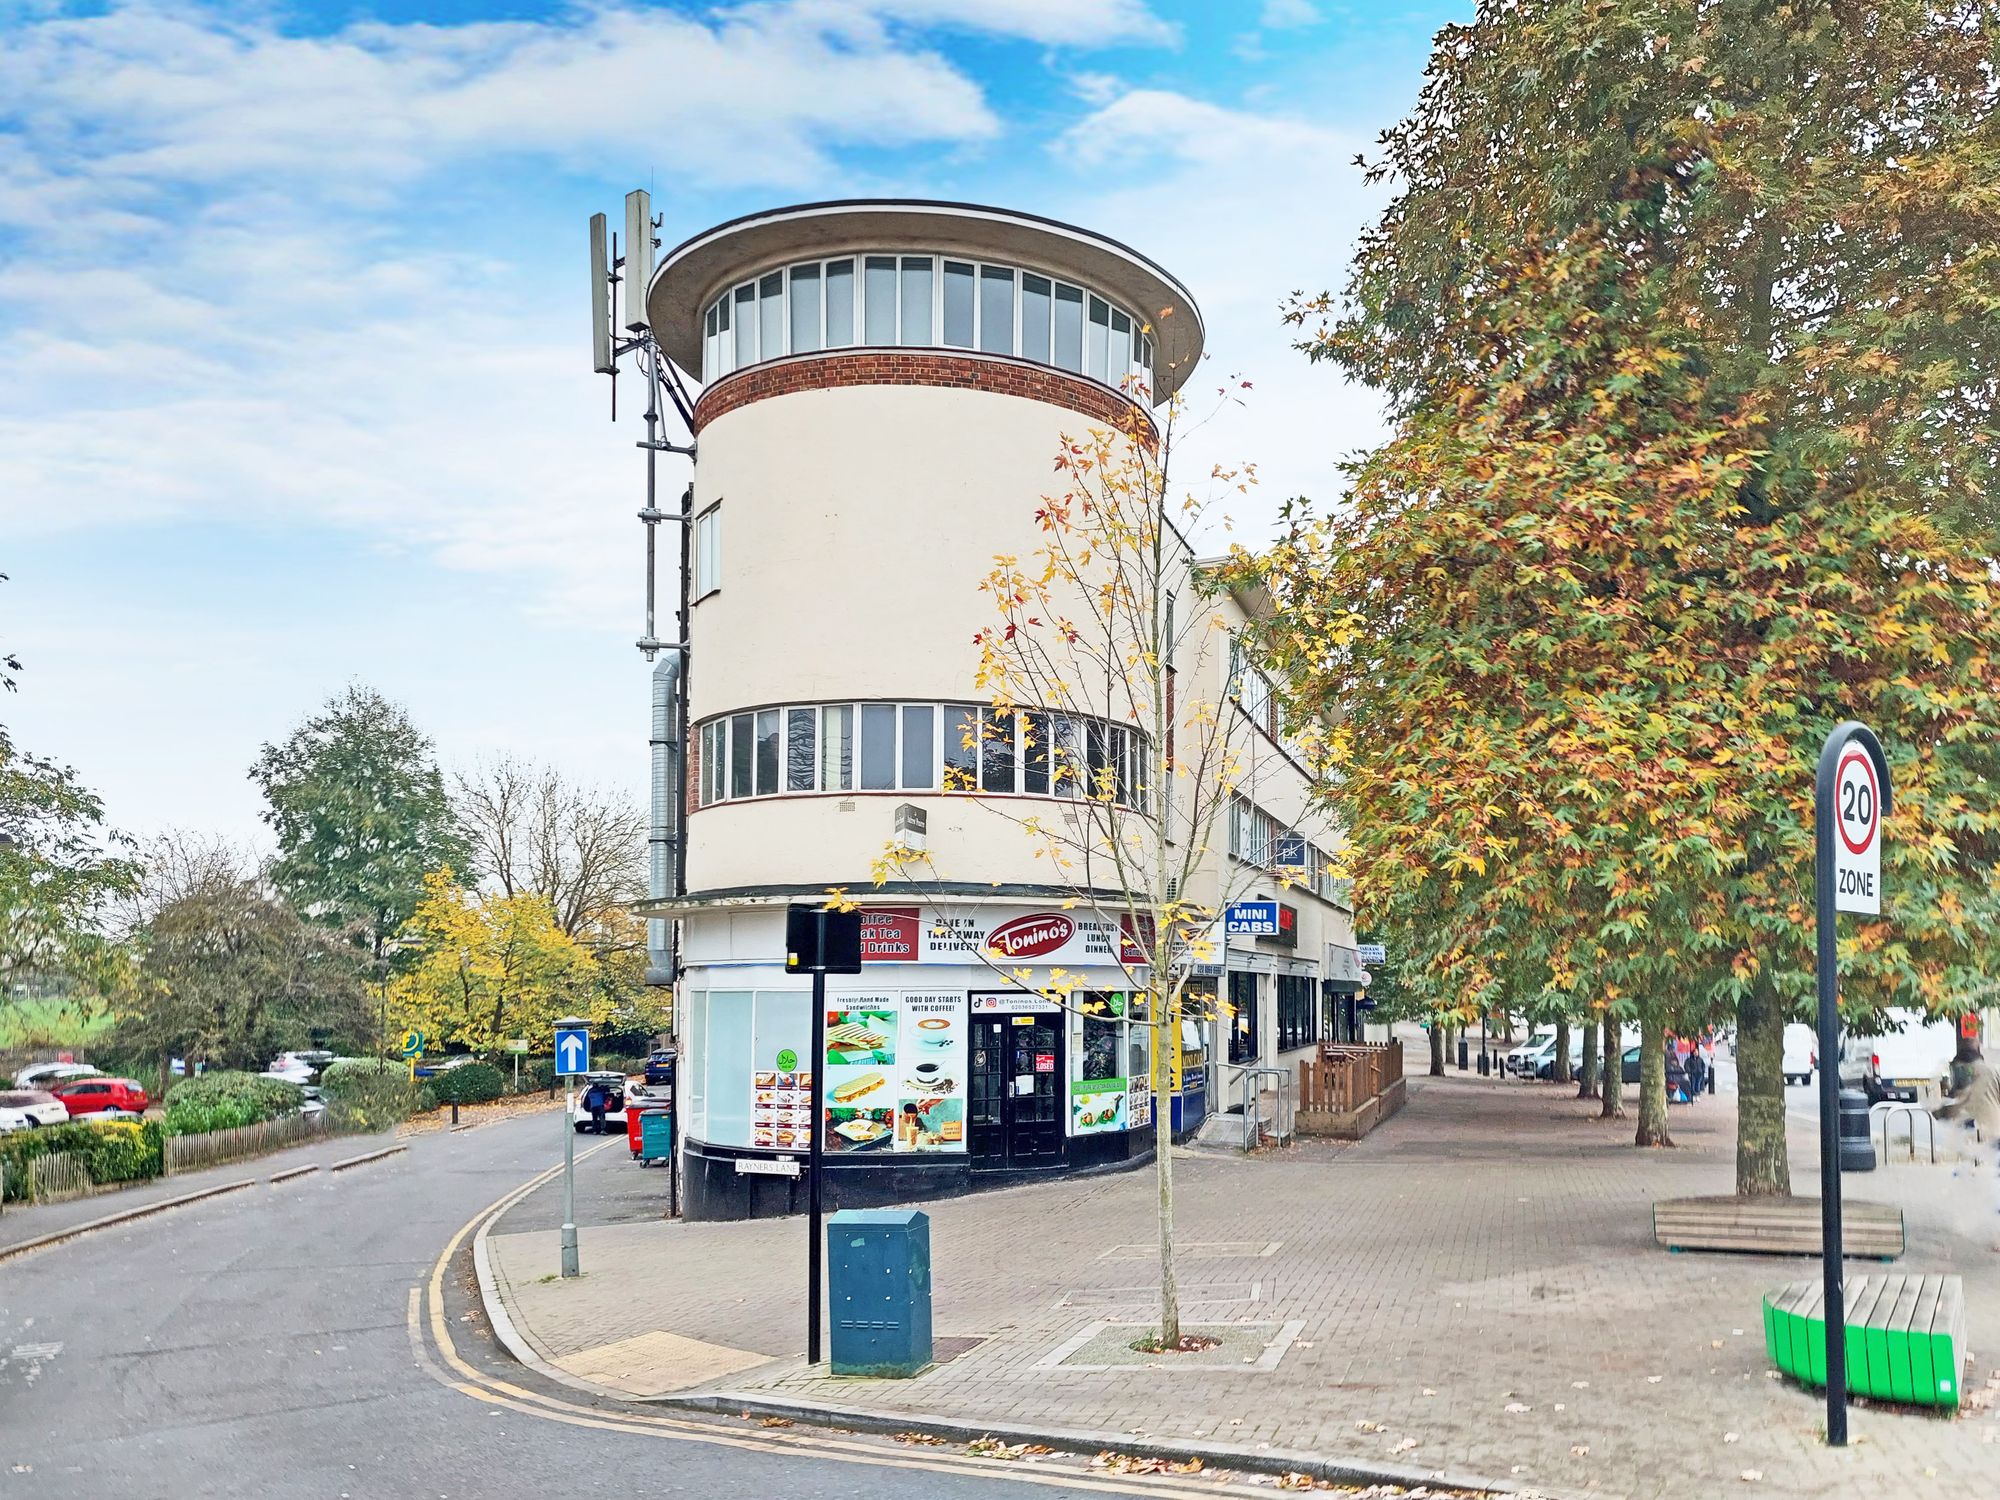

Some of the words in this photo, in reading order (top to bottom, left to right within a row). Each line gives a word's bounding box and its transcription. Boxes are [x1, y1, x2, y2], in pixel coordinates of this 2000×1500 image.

[1843, 780, 1871, 825] 20
[1839, 868, 1873, 897] ZONE
[860, 913, 892, 926] offee
[1234, 909, 1268, 920] MINI
[1227, 921, 1274, 932] CABS
[879, 927, 902, 940] Tea
[991, 917, 1070, 955] Tonino's
[868, 941, 910, 954] Drinks
[930, 942, 980, 952] DELIVERY
[738, 1162, 774, 1173] RAYNERS
[775, 1163, 798, 1173] LANE
